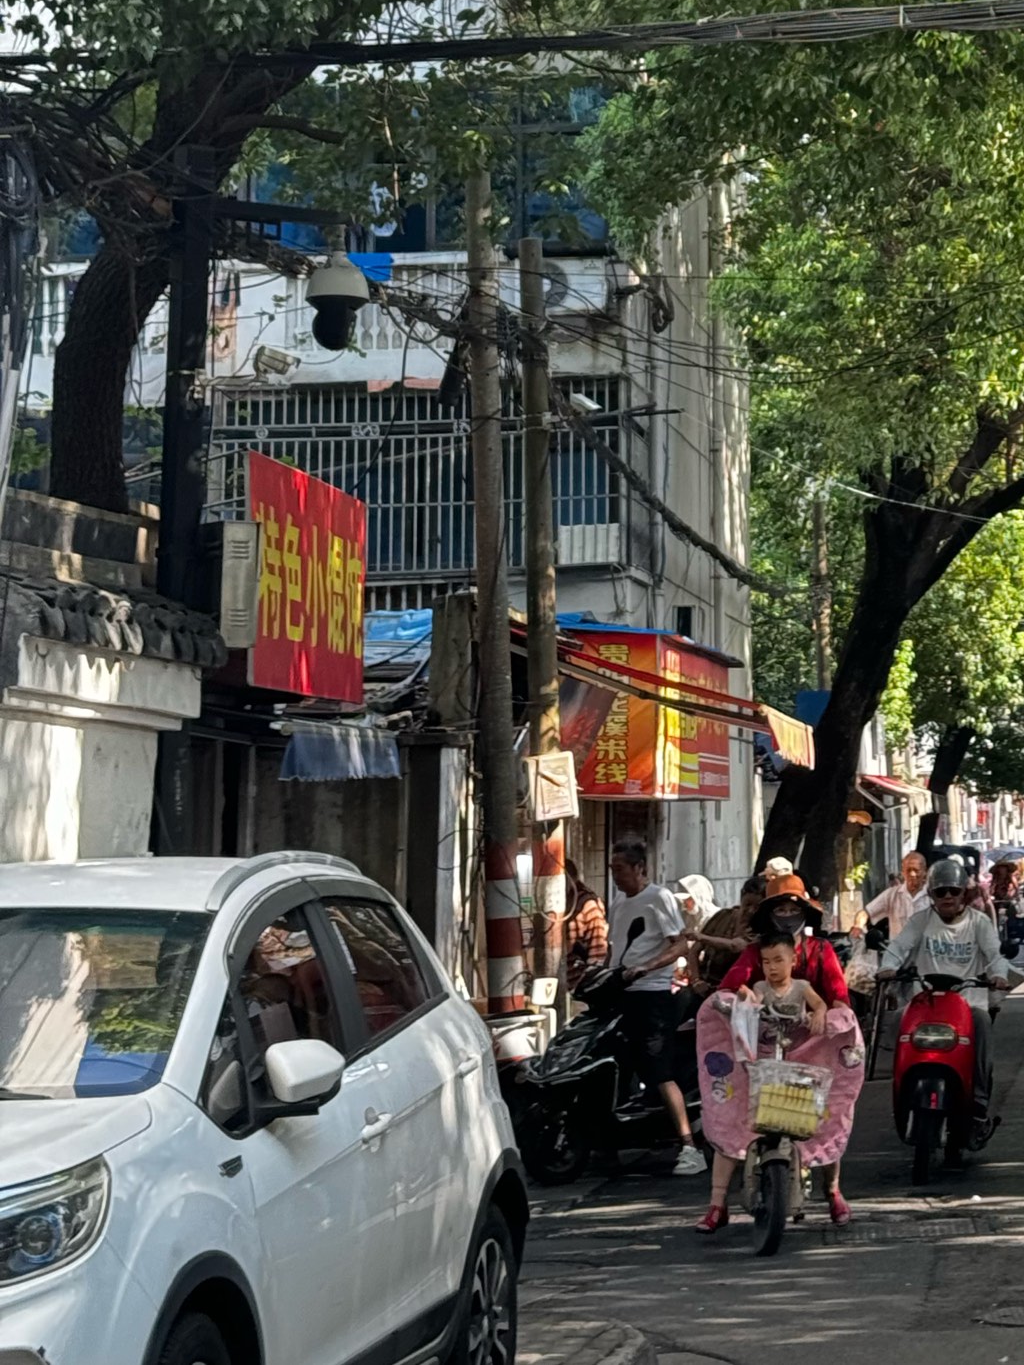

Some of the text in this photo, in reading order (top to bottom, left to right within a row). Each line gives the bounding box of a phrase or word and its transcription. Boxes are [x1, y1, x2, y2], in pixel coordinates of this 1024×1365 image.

[256, 501, 362, 659] 特色小馄饨
